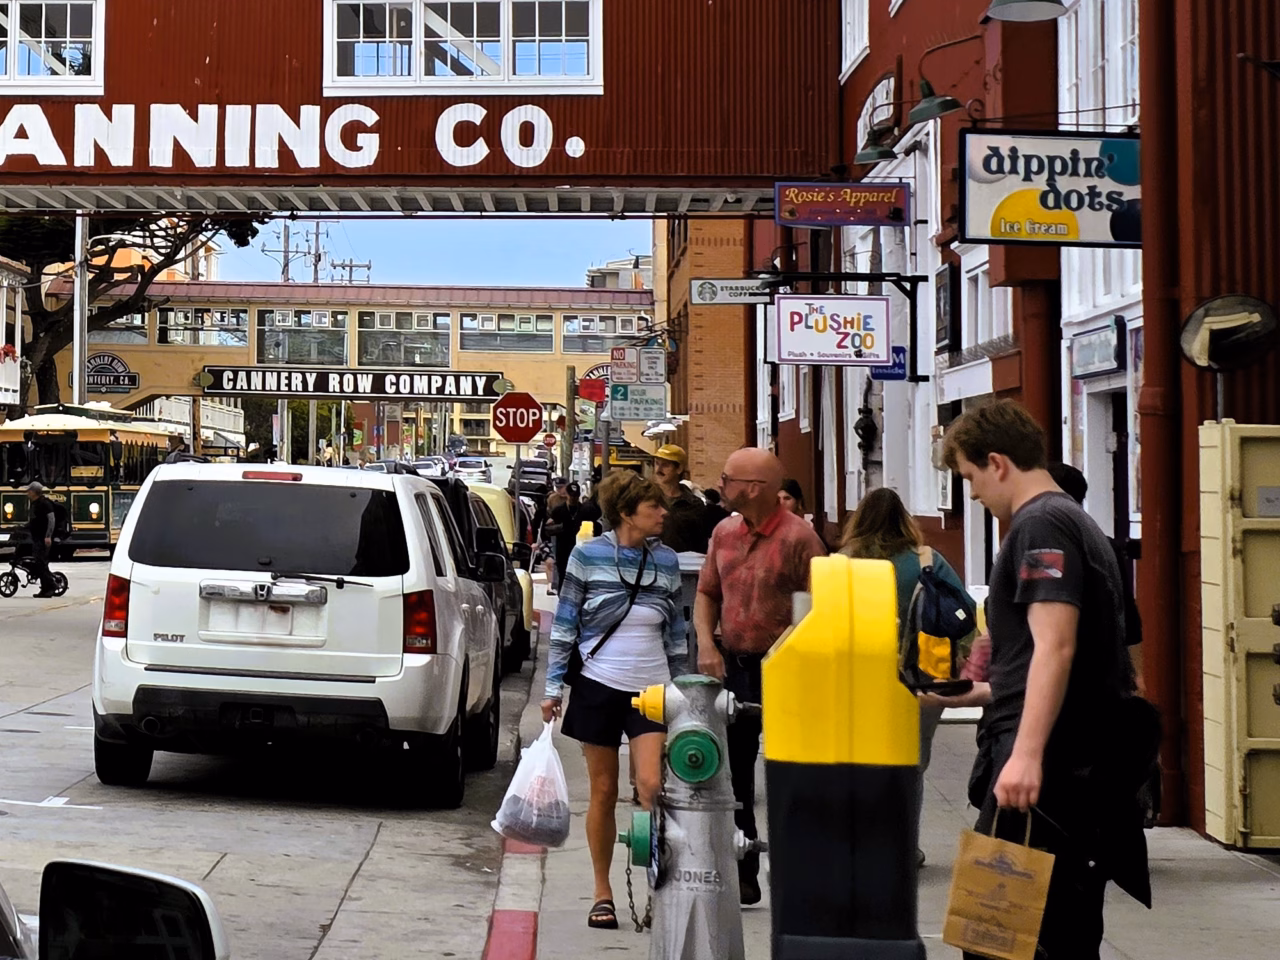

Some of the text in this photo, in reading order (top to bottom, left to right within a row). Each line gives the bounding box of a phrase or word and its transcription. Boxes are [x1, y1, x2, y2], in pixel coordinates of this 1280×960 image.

[436, 103, 585, 168] CO.
[982, 145, 1116, 182] dippin'
[838, 187, 900, 207] Apparel
[1039, 182, 1126, 213] dots
[1000, 218, 1068, 235] Ice Cream
[805, 303, 825, 315] THE
[835, 331, 874, 349] ZOO
[613, 349, 624, 360] NO
[612, 361, 637, 369] PARKING
[223, 371, 487, 395] CANNERY ROW COMPANY
[616, 386, 625, 400] 2
[630, 389, 647, 397] HOUR
[630, 398, 664, 406] PARKING
[496, 408, 540, 428] STOP
[153, 633, 186, 643] PILOT
[675, 869, 721, 883] JONES
